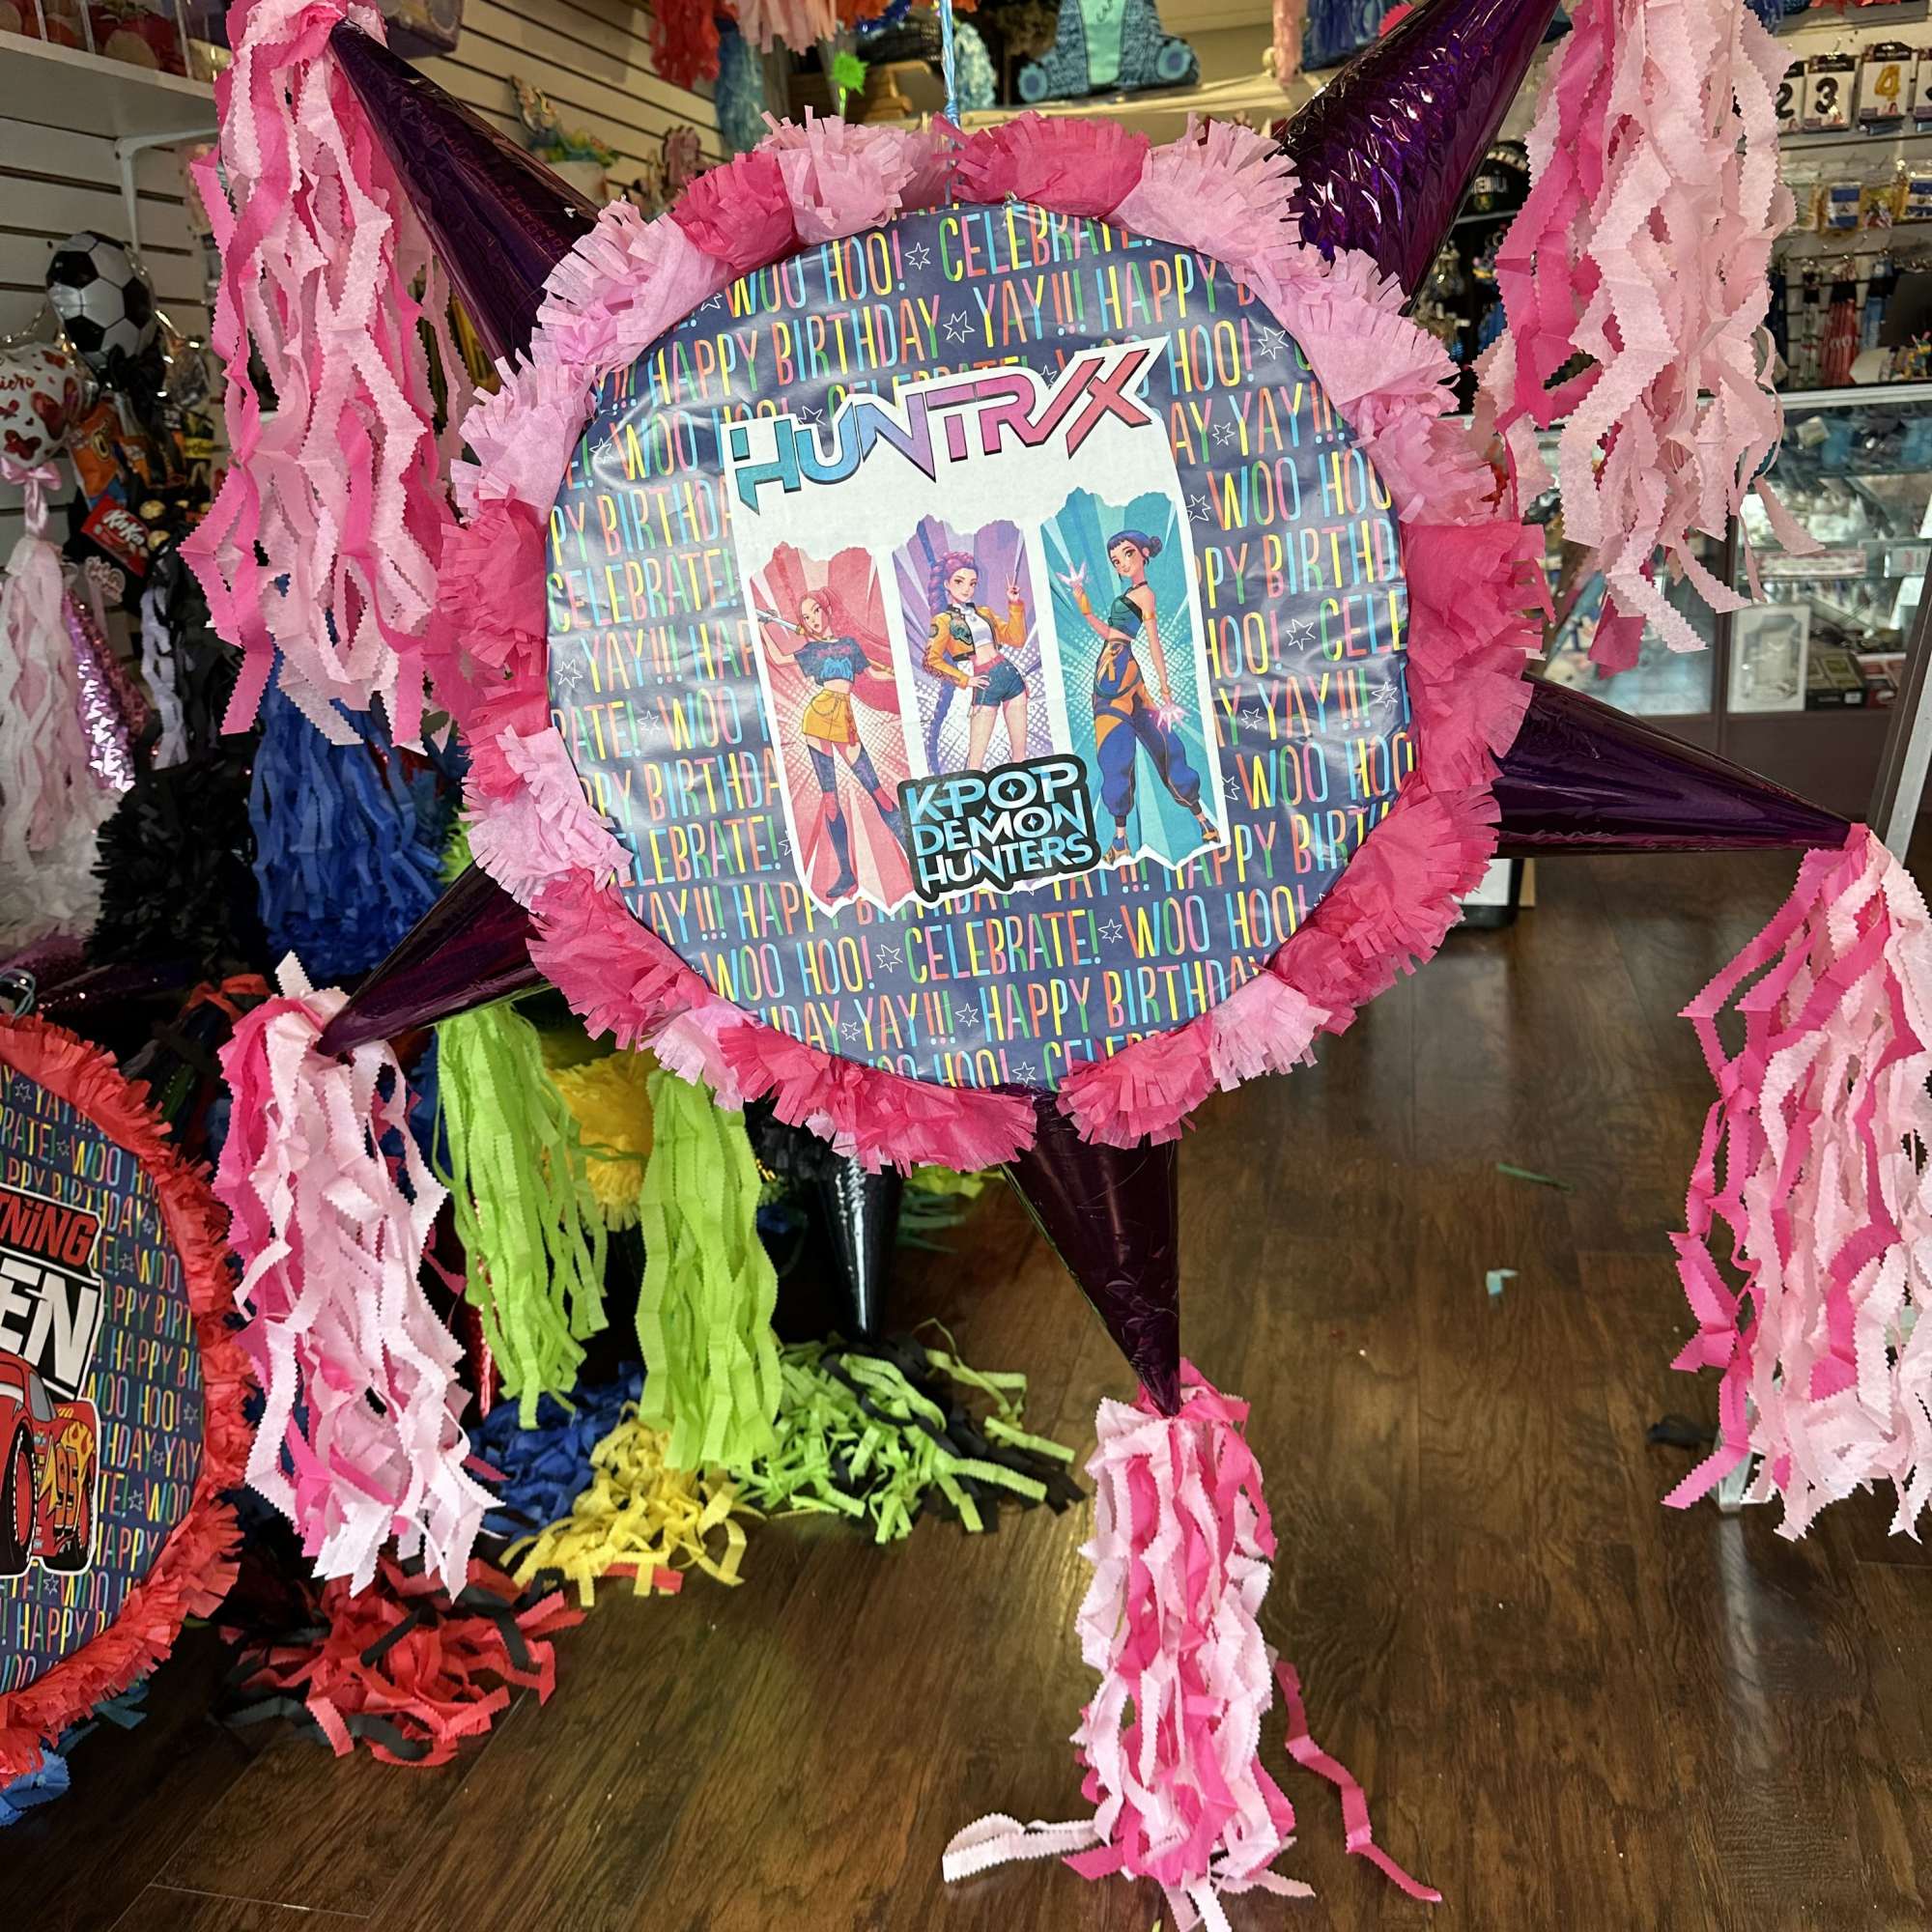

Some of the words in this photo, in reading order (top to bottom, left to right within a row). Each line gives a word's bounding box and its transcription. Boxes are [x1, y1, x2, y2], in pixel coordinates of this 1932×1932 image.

[1776, 82, 1794, 119] 2
[1815, 77, 1838, 114] 3
[1874, 64, 1900, 101] 4
[820, 230, 906, 305] HOO!
[973, 269, 1087, 349] YAY!!!
[1095, 253, 1217, 333] HAPPY
[647, 329, 758, 408] HAPPY
[771, 295, 940, 386] BIRTHDAY
[1165, 318, 1254, 395] HOO!
[609, 410, 698, 481] WOO
[1206, 456, 1301, 531] WOO
[547, 548, 738, 633] CELEBRATE!
[1262, 518, 1406, 599] BIRTHD
[581, 625, 682, 694] YAY!!!
[657, 686, 743, 752] WOO
[1257, 668, 1371, 741] YAY!!!
[1236, 741, 1329, 810] WOO
[912, 789, 1088, 857] DEMON
[918, 833, 1094, 895] HUNTERS
[904, 909, 1101, 983] CELEBRATE!
[1120, 895, 1210, 959] WOO
[700, 943, 785, 1003] WOO
[796, 935, 875, 997] HOO!
[854, 990, 956, 1051] YAY!!!
[979, 977, 1090, 1043] HAPPY
[71, 1135, 122, 1187] WOO
[135, 1243, 180, 1293] WOO
[110, 1328, 173, 1384] HAPPY
[137, 1383, 181, 1433] HOO!
[145, 1478, 190, 1525] WOO
[15, 1602, 89, 1655] HAPPY
